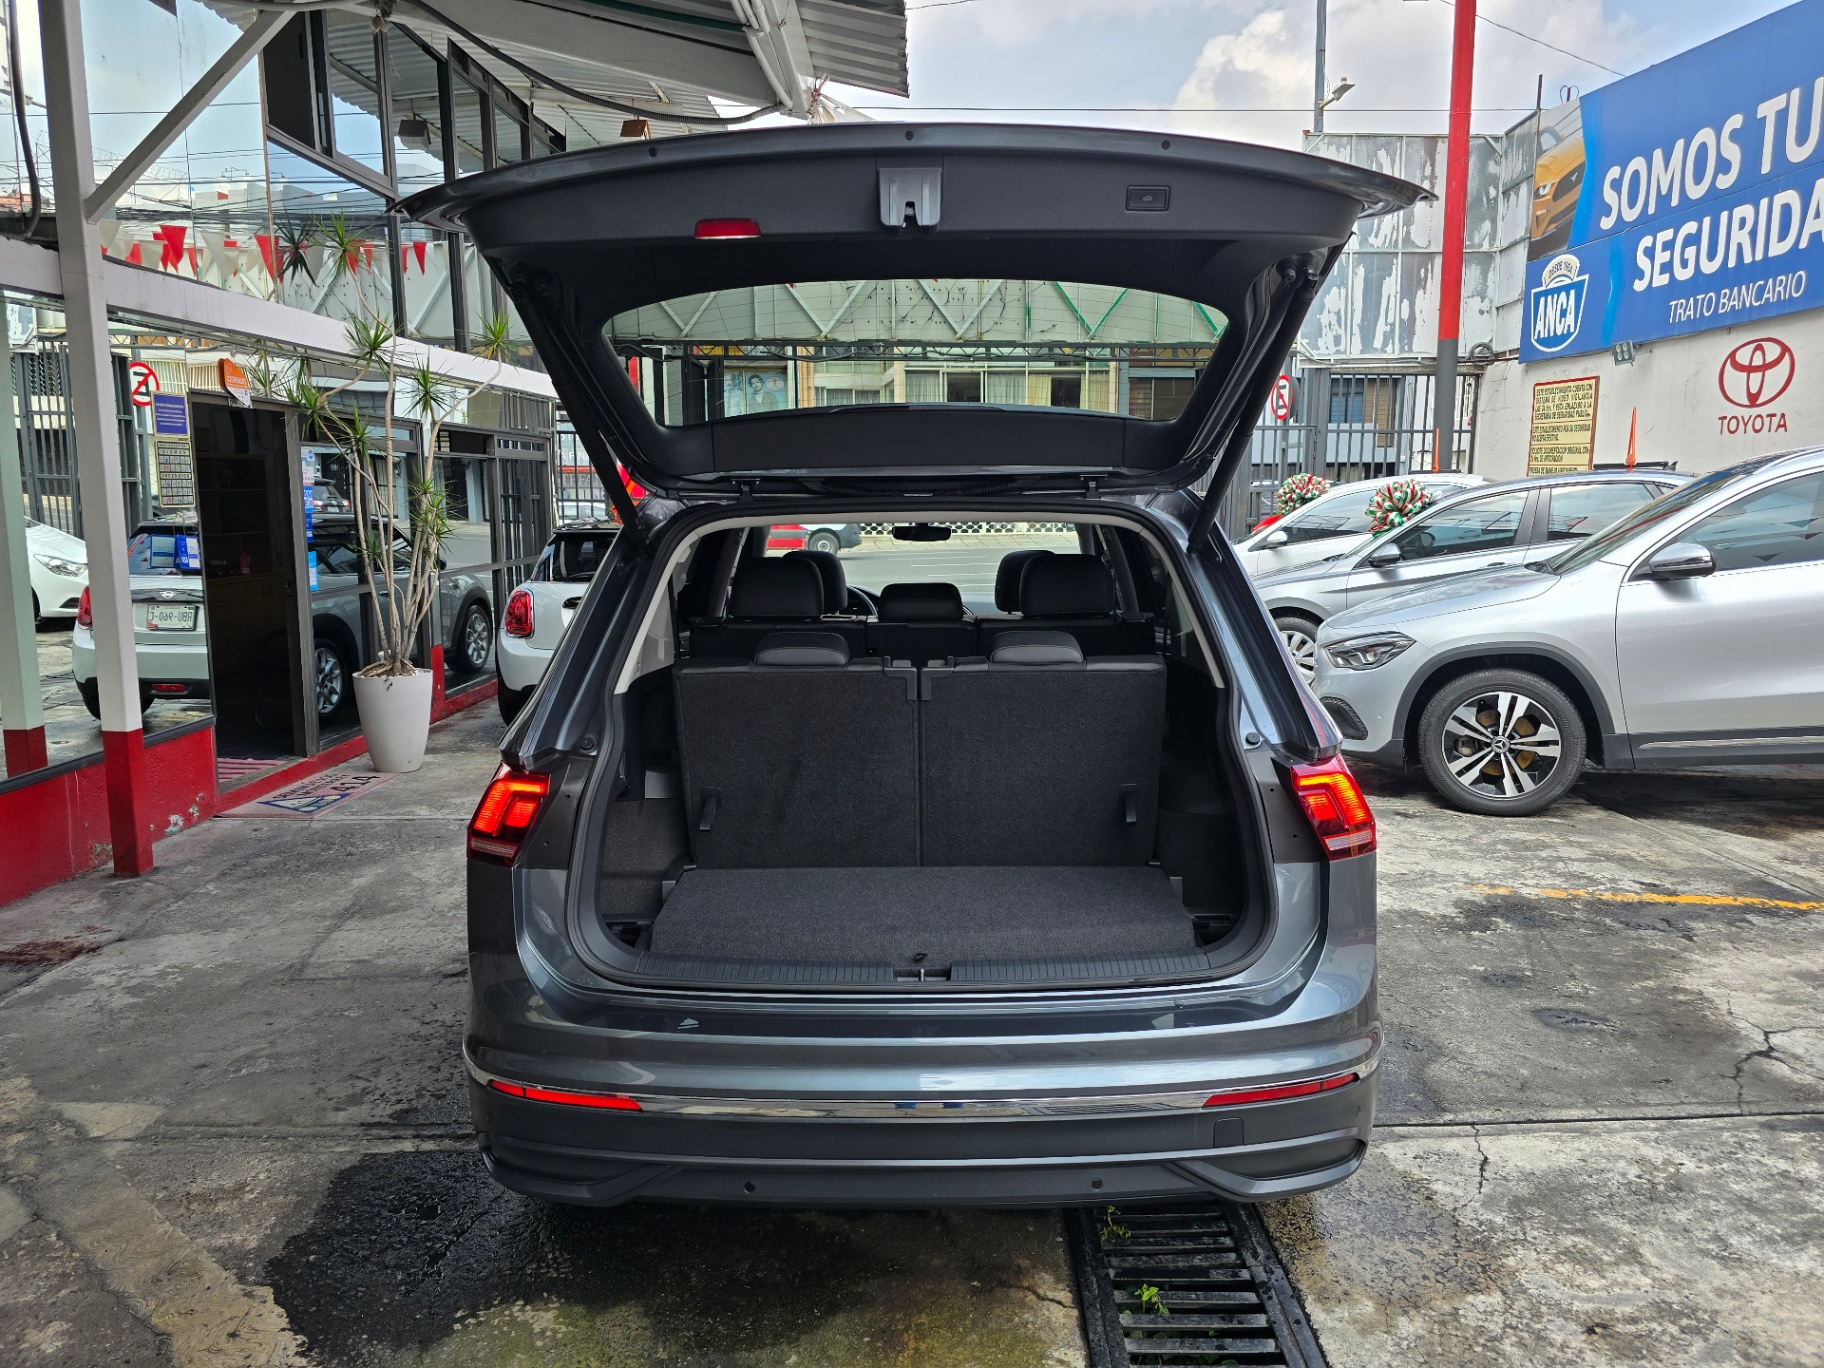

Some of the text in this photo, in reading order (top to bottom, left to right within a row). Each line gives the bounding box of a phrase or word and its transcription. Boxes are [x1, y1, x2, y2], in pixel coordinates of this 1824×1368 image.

[1600, 76, 1824, 230] SOMOS TU
[1633, 178, 1824, 292] SEGURIDA
[1534, 289, 1575, 339] ANCA
[1669, 271, 1806, 323] TRATO BANCARIO
[1718, 413, 1788, 435] TOYOTA
